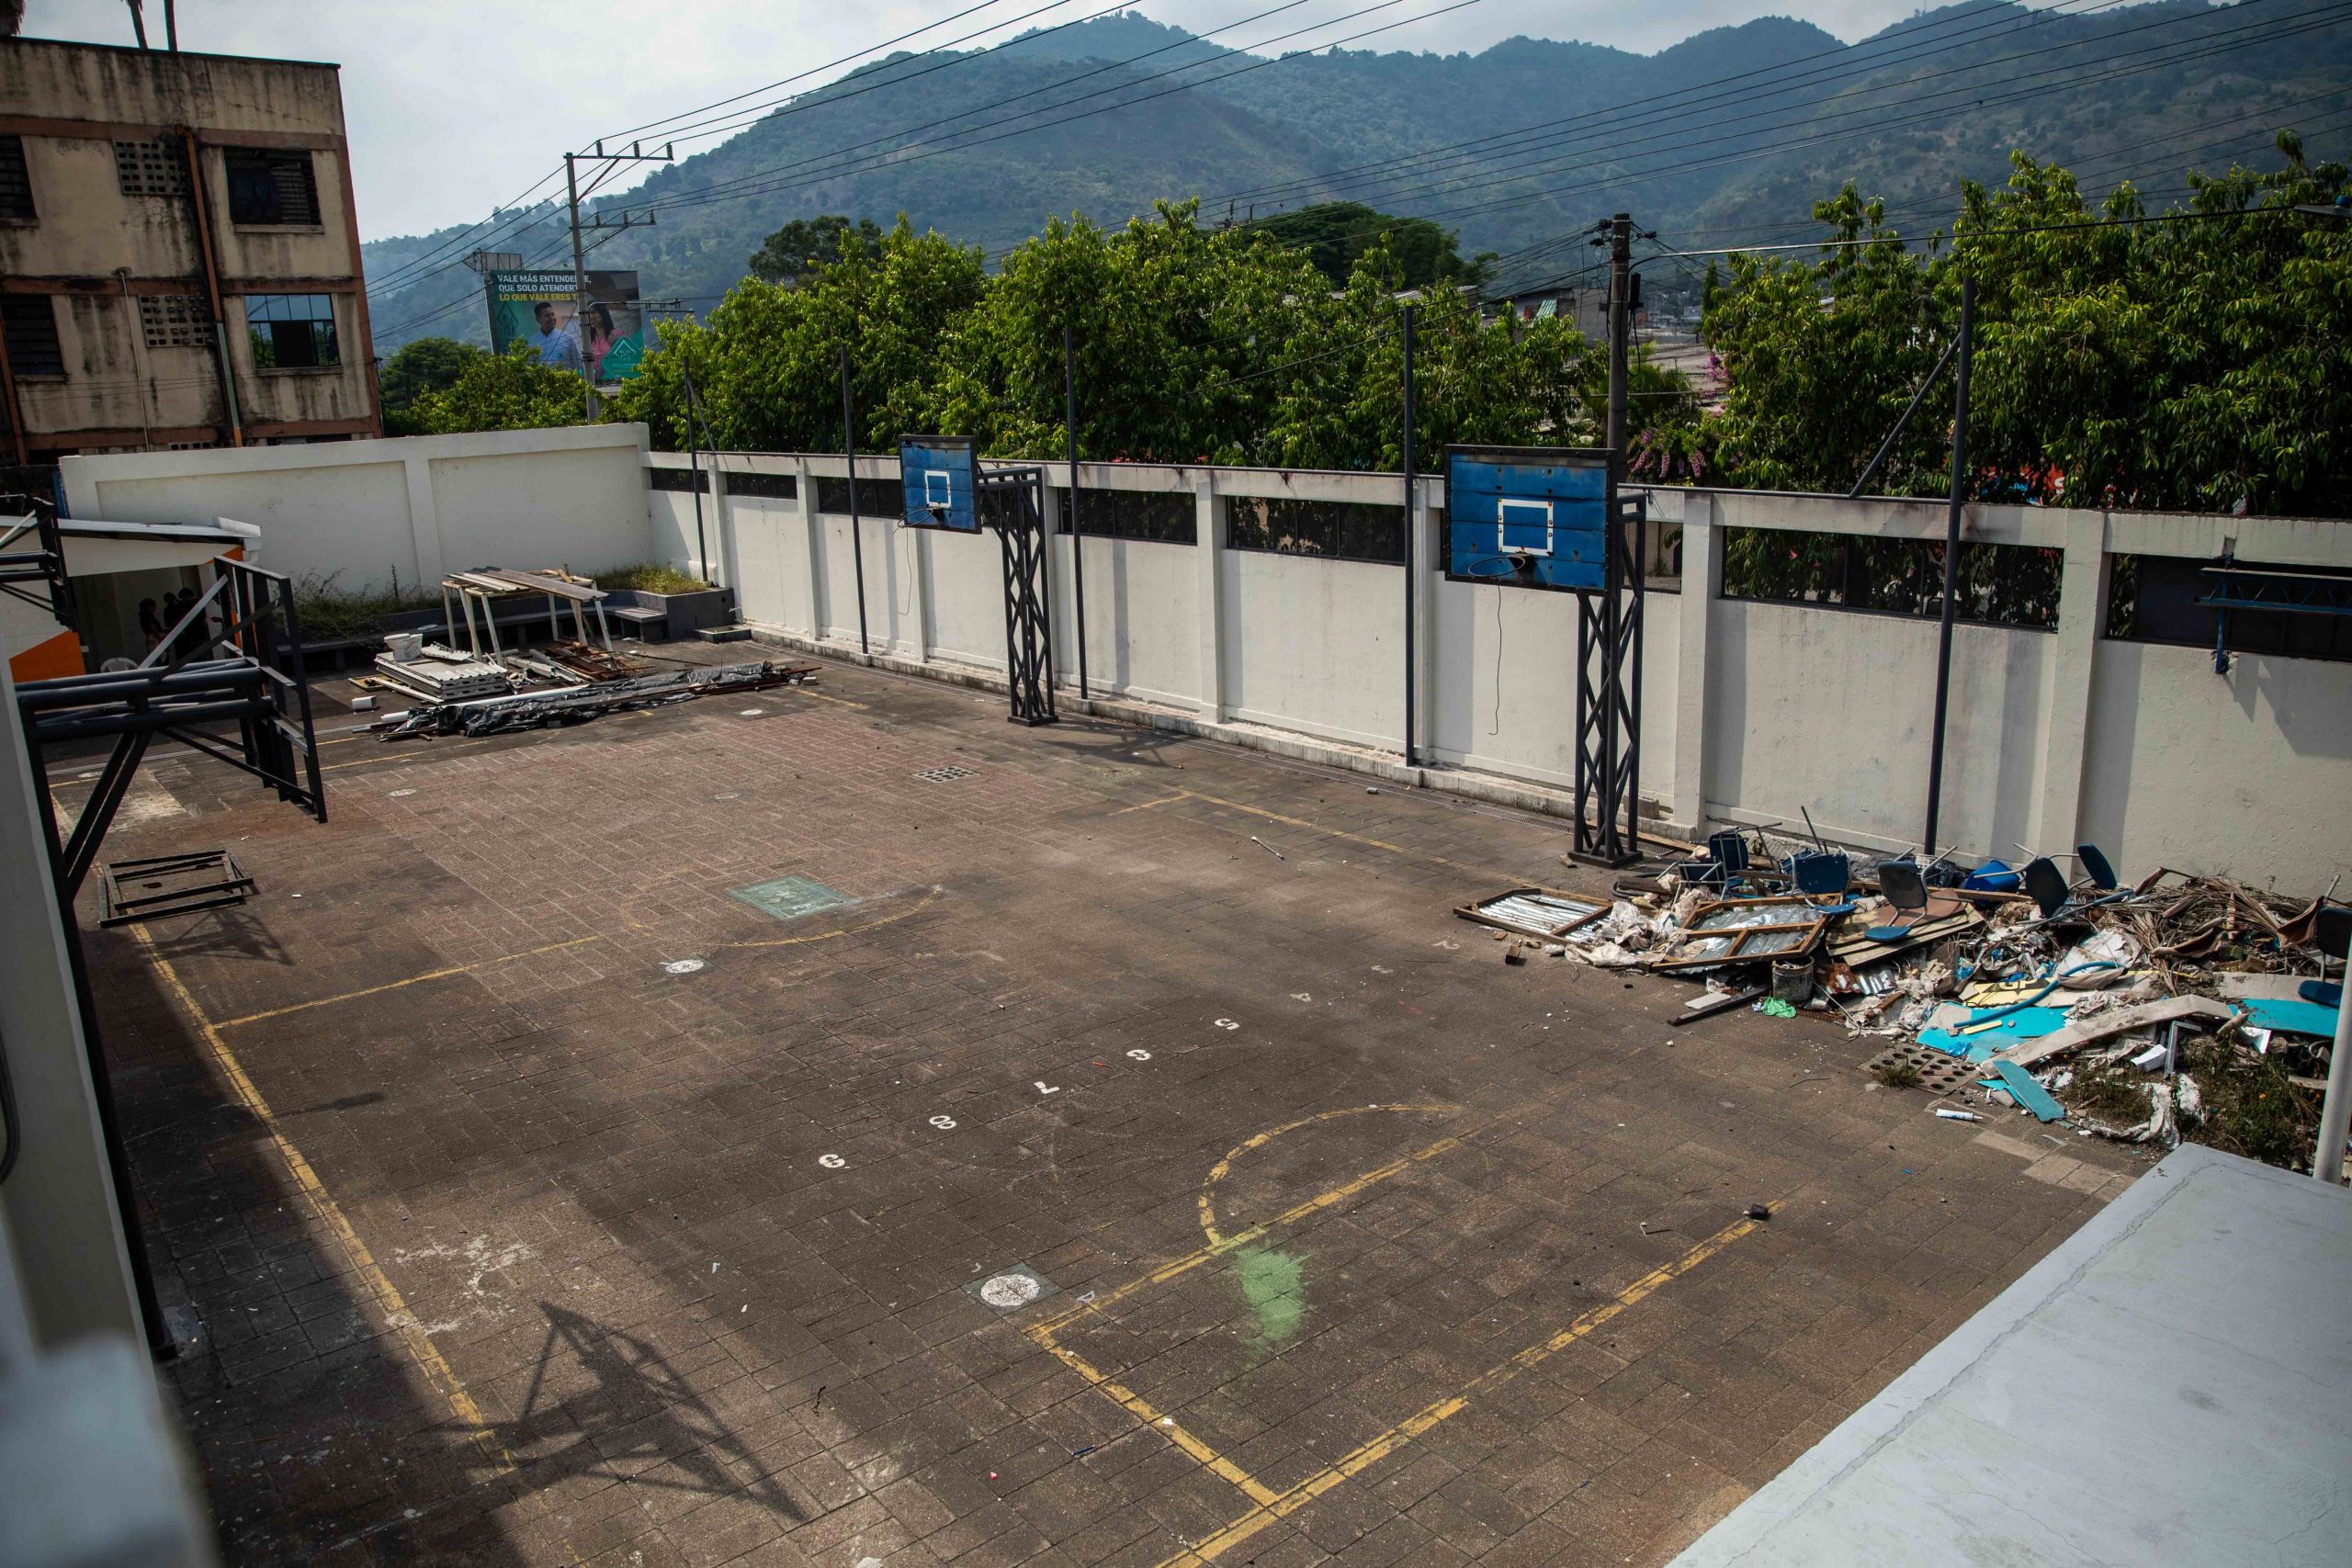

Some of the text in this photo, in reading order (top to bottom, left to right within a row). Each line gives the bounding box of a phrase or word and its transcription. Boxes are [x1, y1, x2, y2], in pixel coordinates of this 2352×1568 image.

[497, 273, 592, 284] VALE MÁS ENTENDEE,
[498, 284, 515, 292] QUE
[516, 284, 537, 292] SOLO
[499, 293, 580, 301] LO QUE VALE ERES T
[929, 1114, 957, 1130] 8
